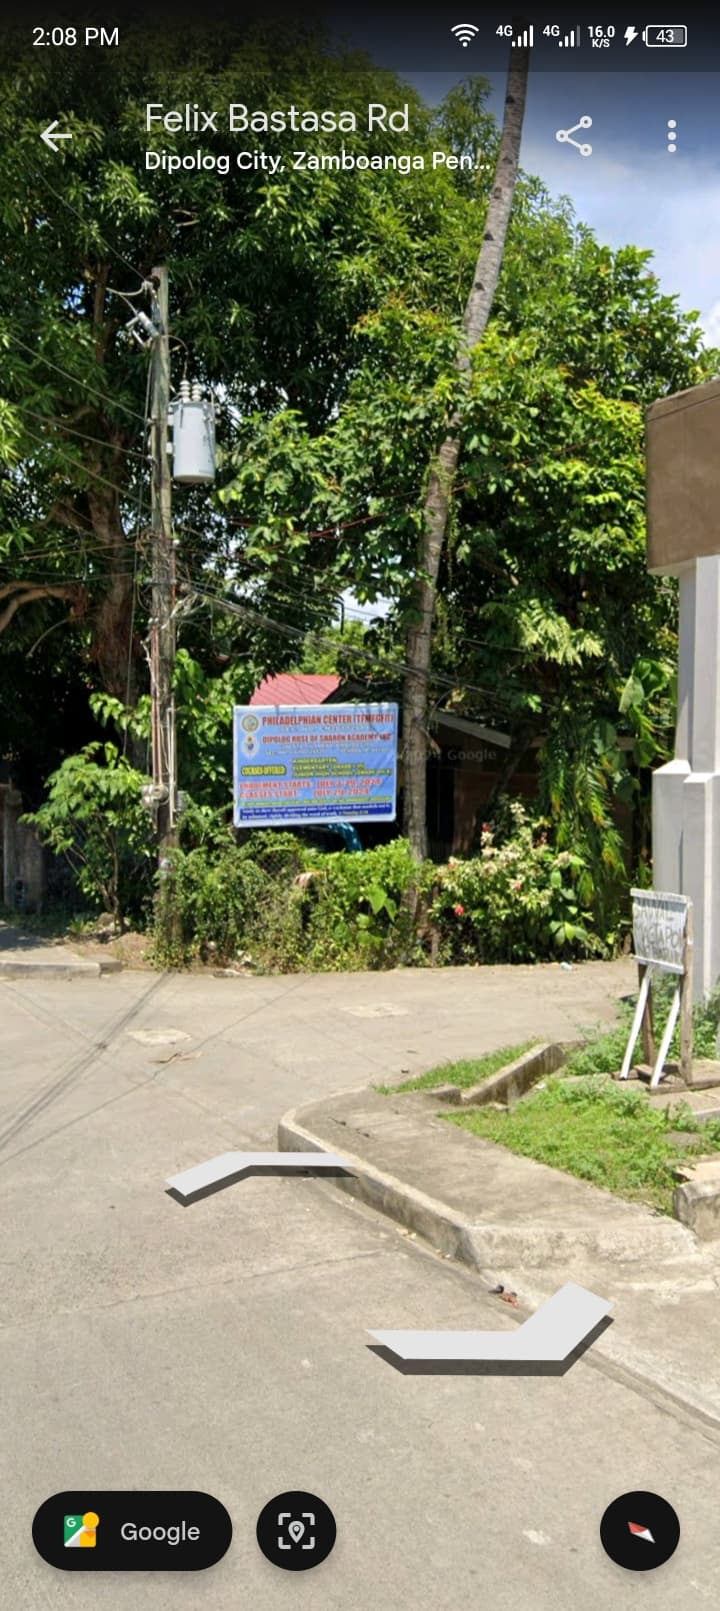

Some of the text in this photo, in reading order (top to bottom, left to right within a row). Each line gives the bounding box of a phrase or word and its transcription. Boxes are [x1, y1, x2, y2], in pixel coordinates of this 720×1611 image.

[262, 714, 321, 727] PHILADELPHIAN
[323, 713, 353, 725] CENTER
[262, 735, 291, 745] DIPOLOG
[347, 733, 378, 742] ACADEMY
